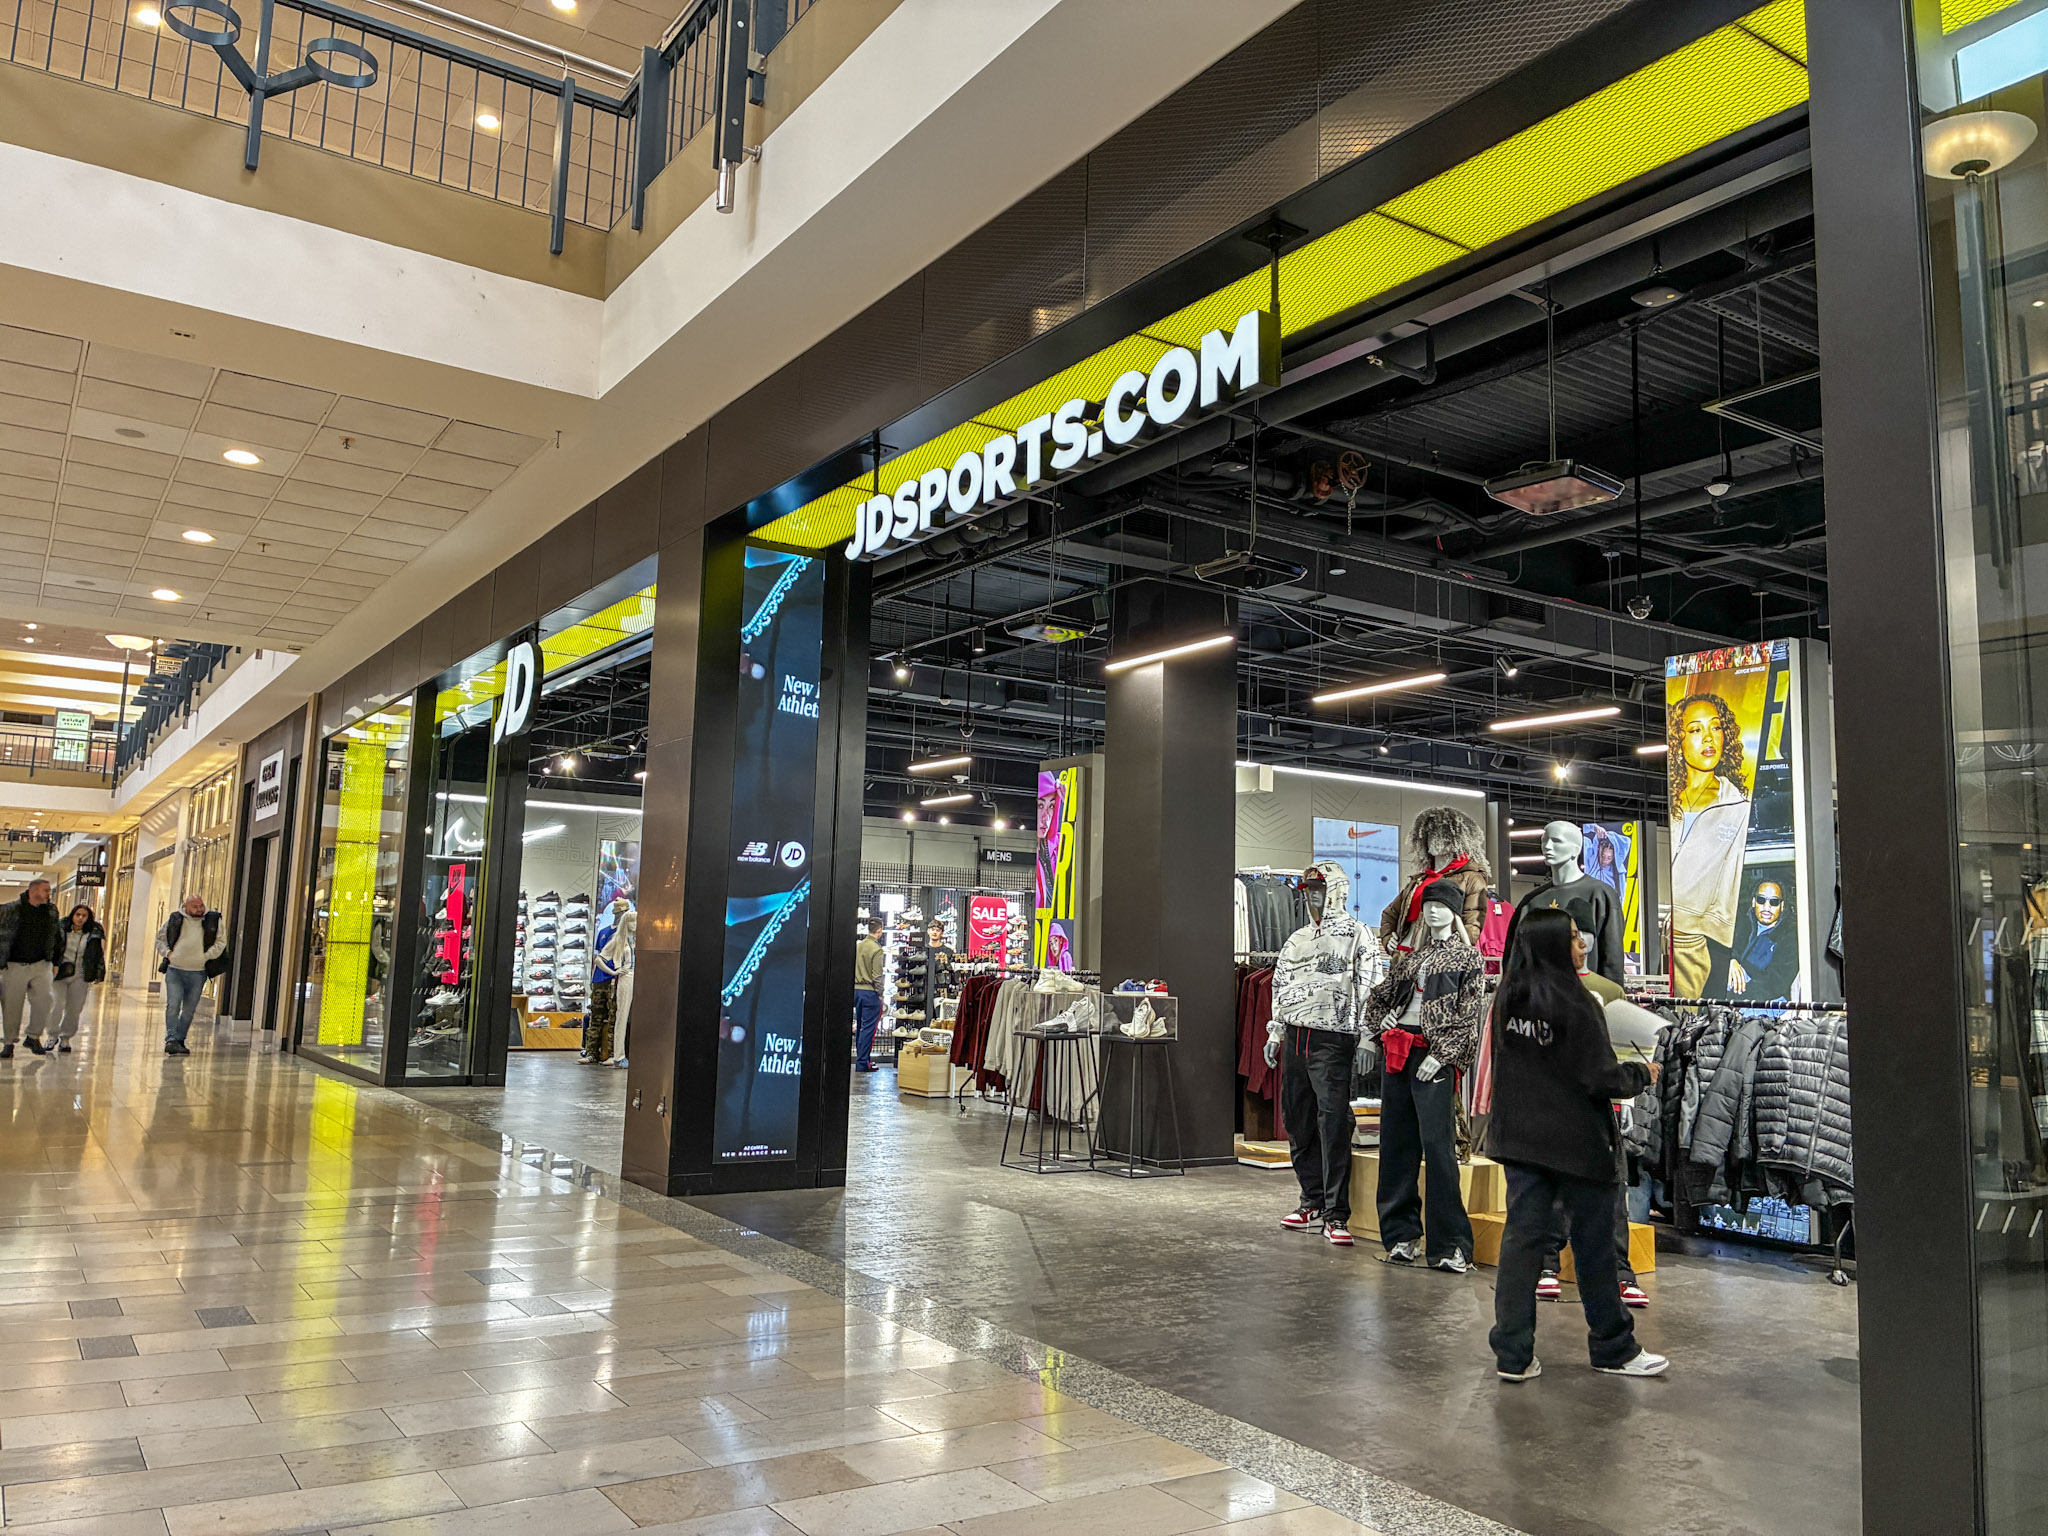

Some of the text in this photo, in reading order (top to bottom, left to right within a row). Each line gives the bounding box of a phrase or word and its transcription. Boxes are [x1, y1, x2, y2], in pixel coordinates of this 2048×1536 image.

[844, 309, 1260, 562] JDSPORTS.COM
[493, 641, 536, 745] JD
[783, 674, 814, 697] New
[785, 848, 802, 861] JD
[986, 851, 1012, 862] MENS
[972, 906, 1006, 921] SALE
[764, 1032, 797, 1053] New
